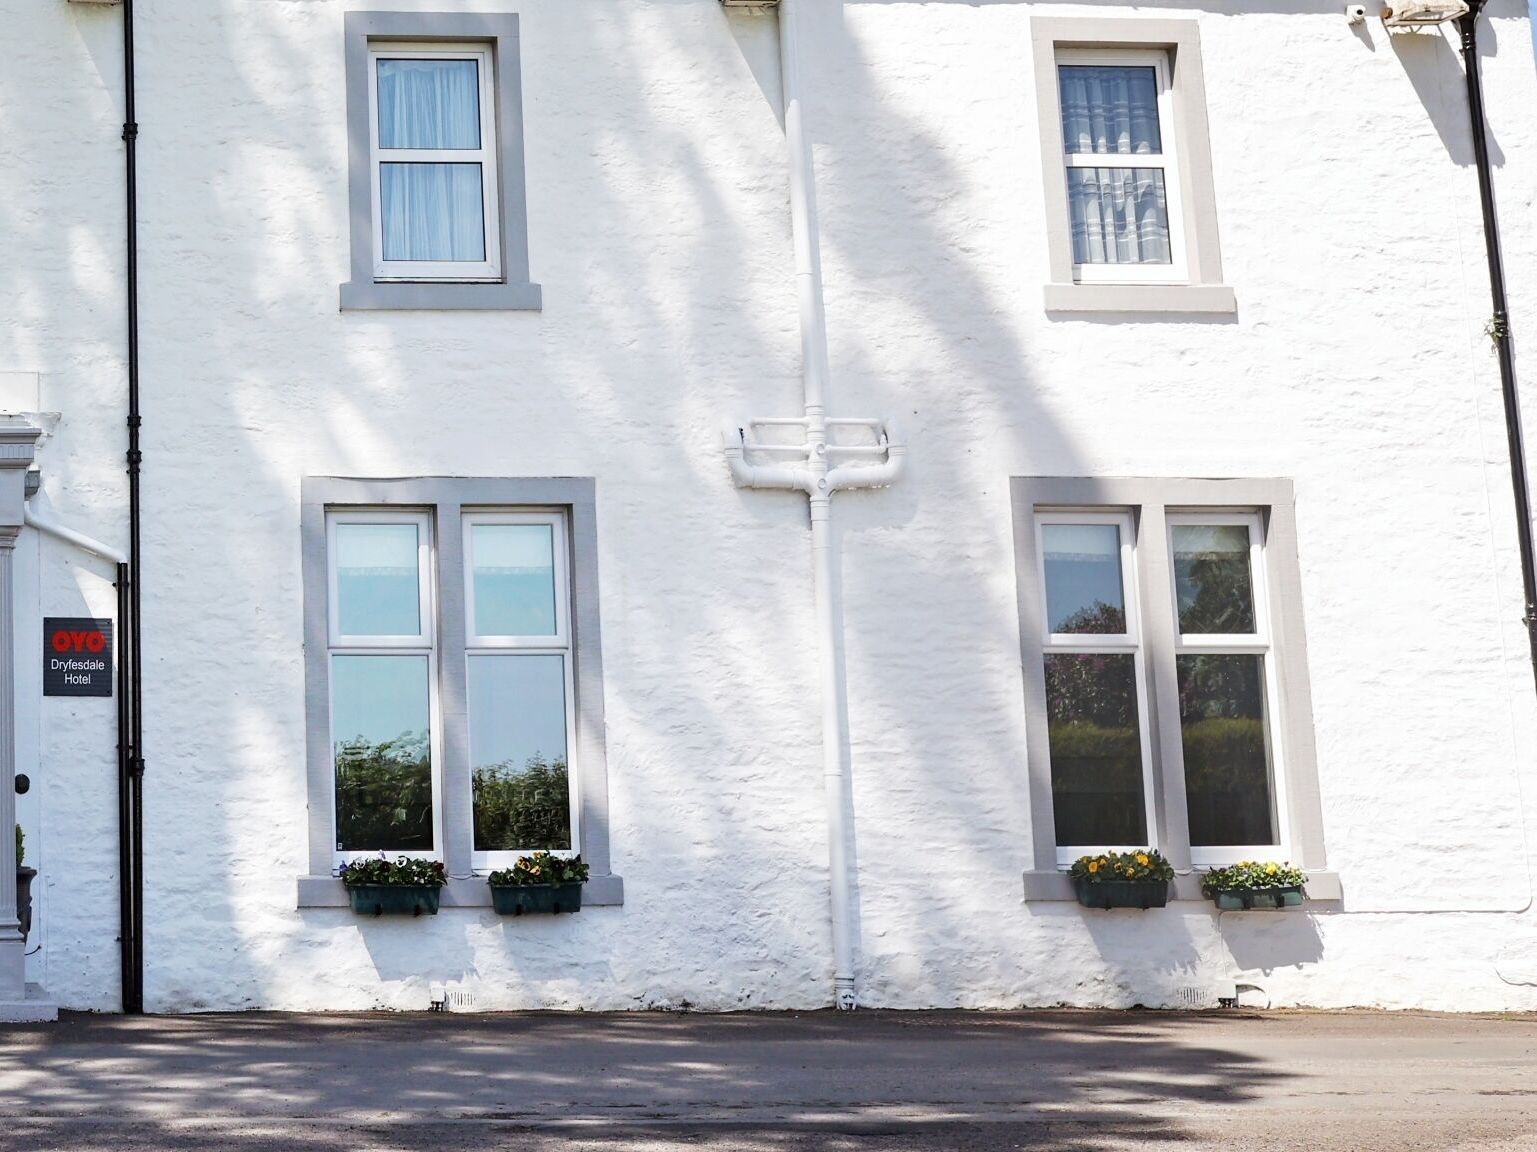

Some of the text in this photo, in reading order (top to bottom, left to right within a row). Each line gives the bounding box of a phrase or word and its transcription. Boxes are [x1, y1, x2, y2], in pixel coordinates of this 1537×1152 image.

[51, 630, 106, 653] OYO
[51, 658, 105, 672] Dryfesdale
[64, 673, 91, 684] Hotel
